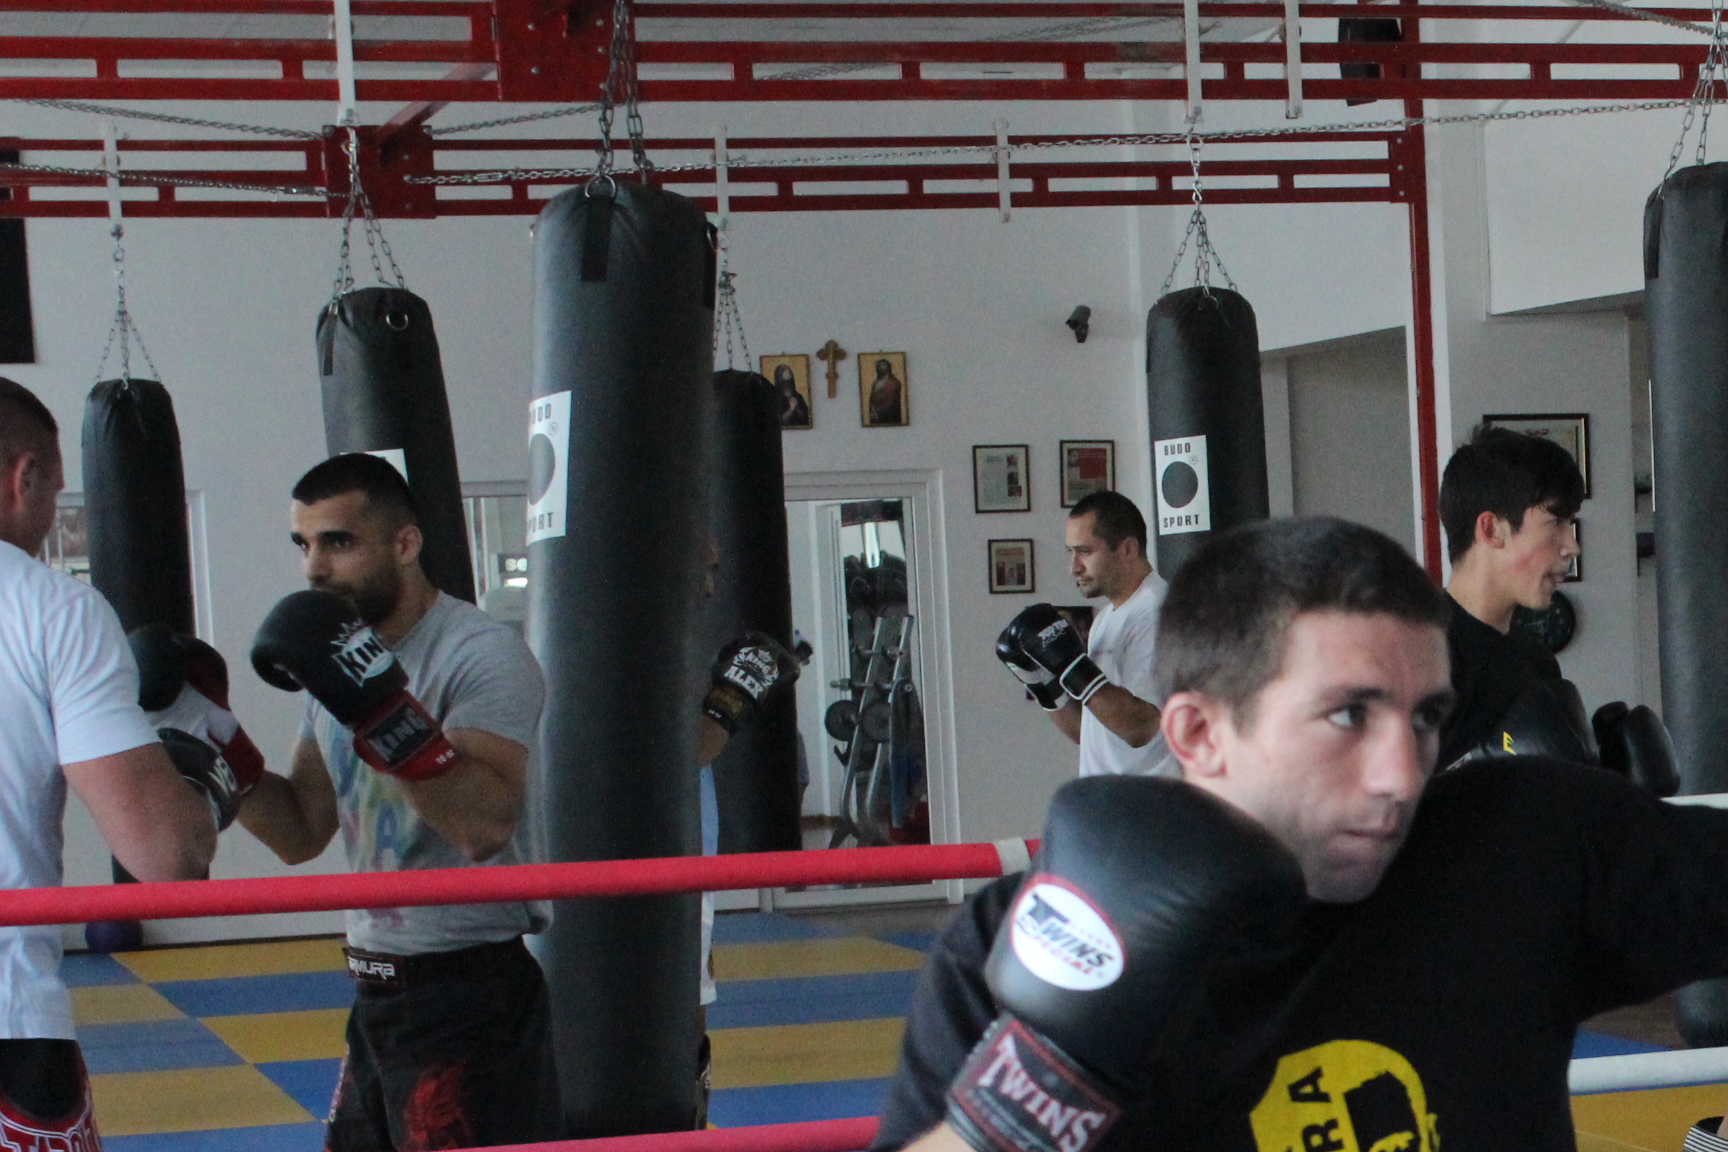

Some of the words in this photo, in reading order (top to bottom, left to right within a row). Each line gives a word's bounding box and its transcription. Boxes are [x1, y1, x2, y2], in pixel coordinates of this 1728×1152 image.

[1164, 442, 1191, 456] BUDO
[1163, 514, 1200, 529] SPORT
[723, 665, 765, 700] ALEX
[1016, 891, 1115, 968] TWINS
